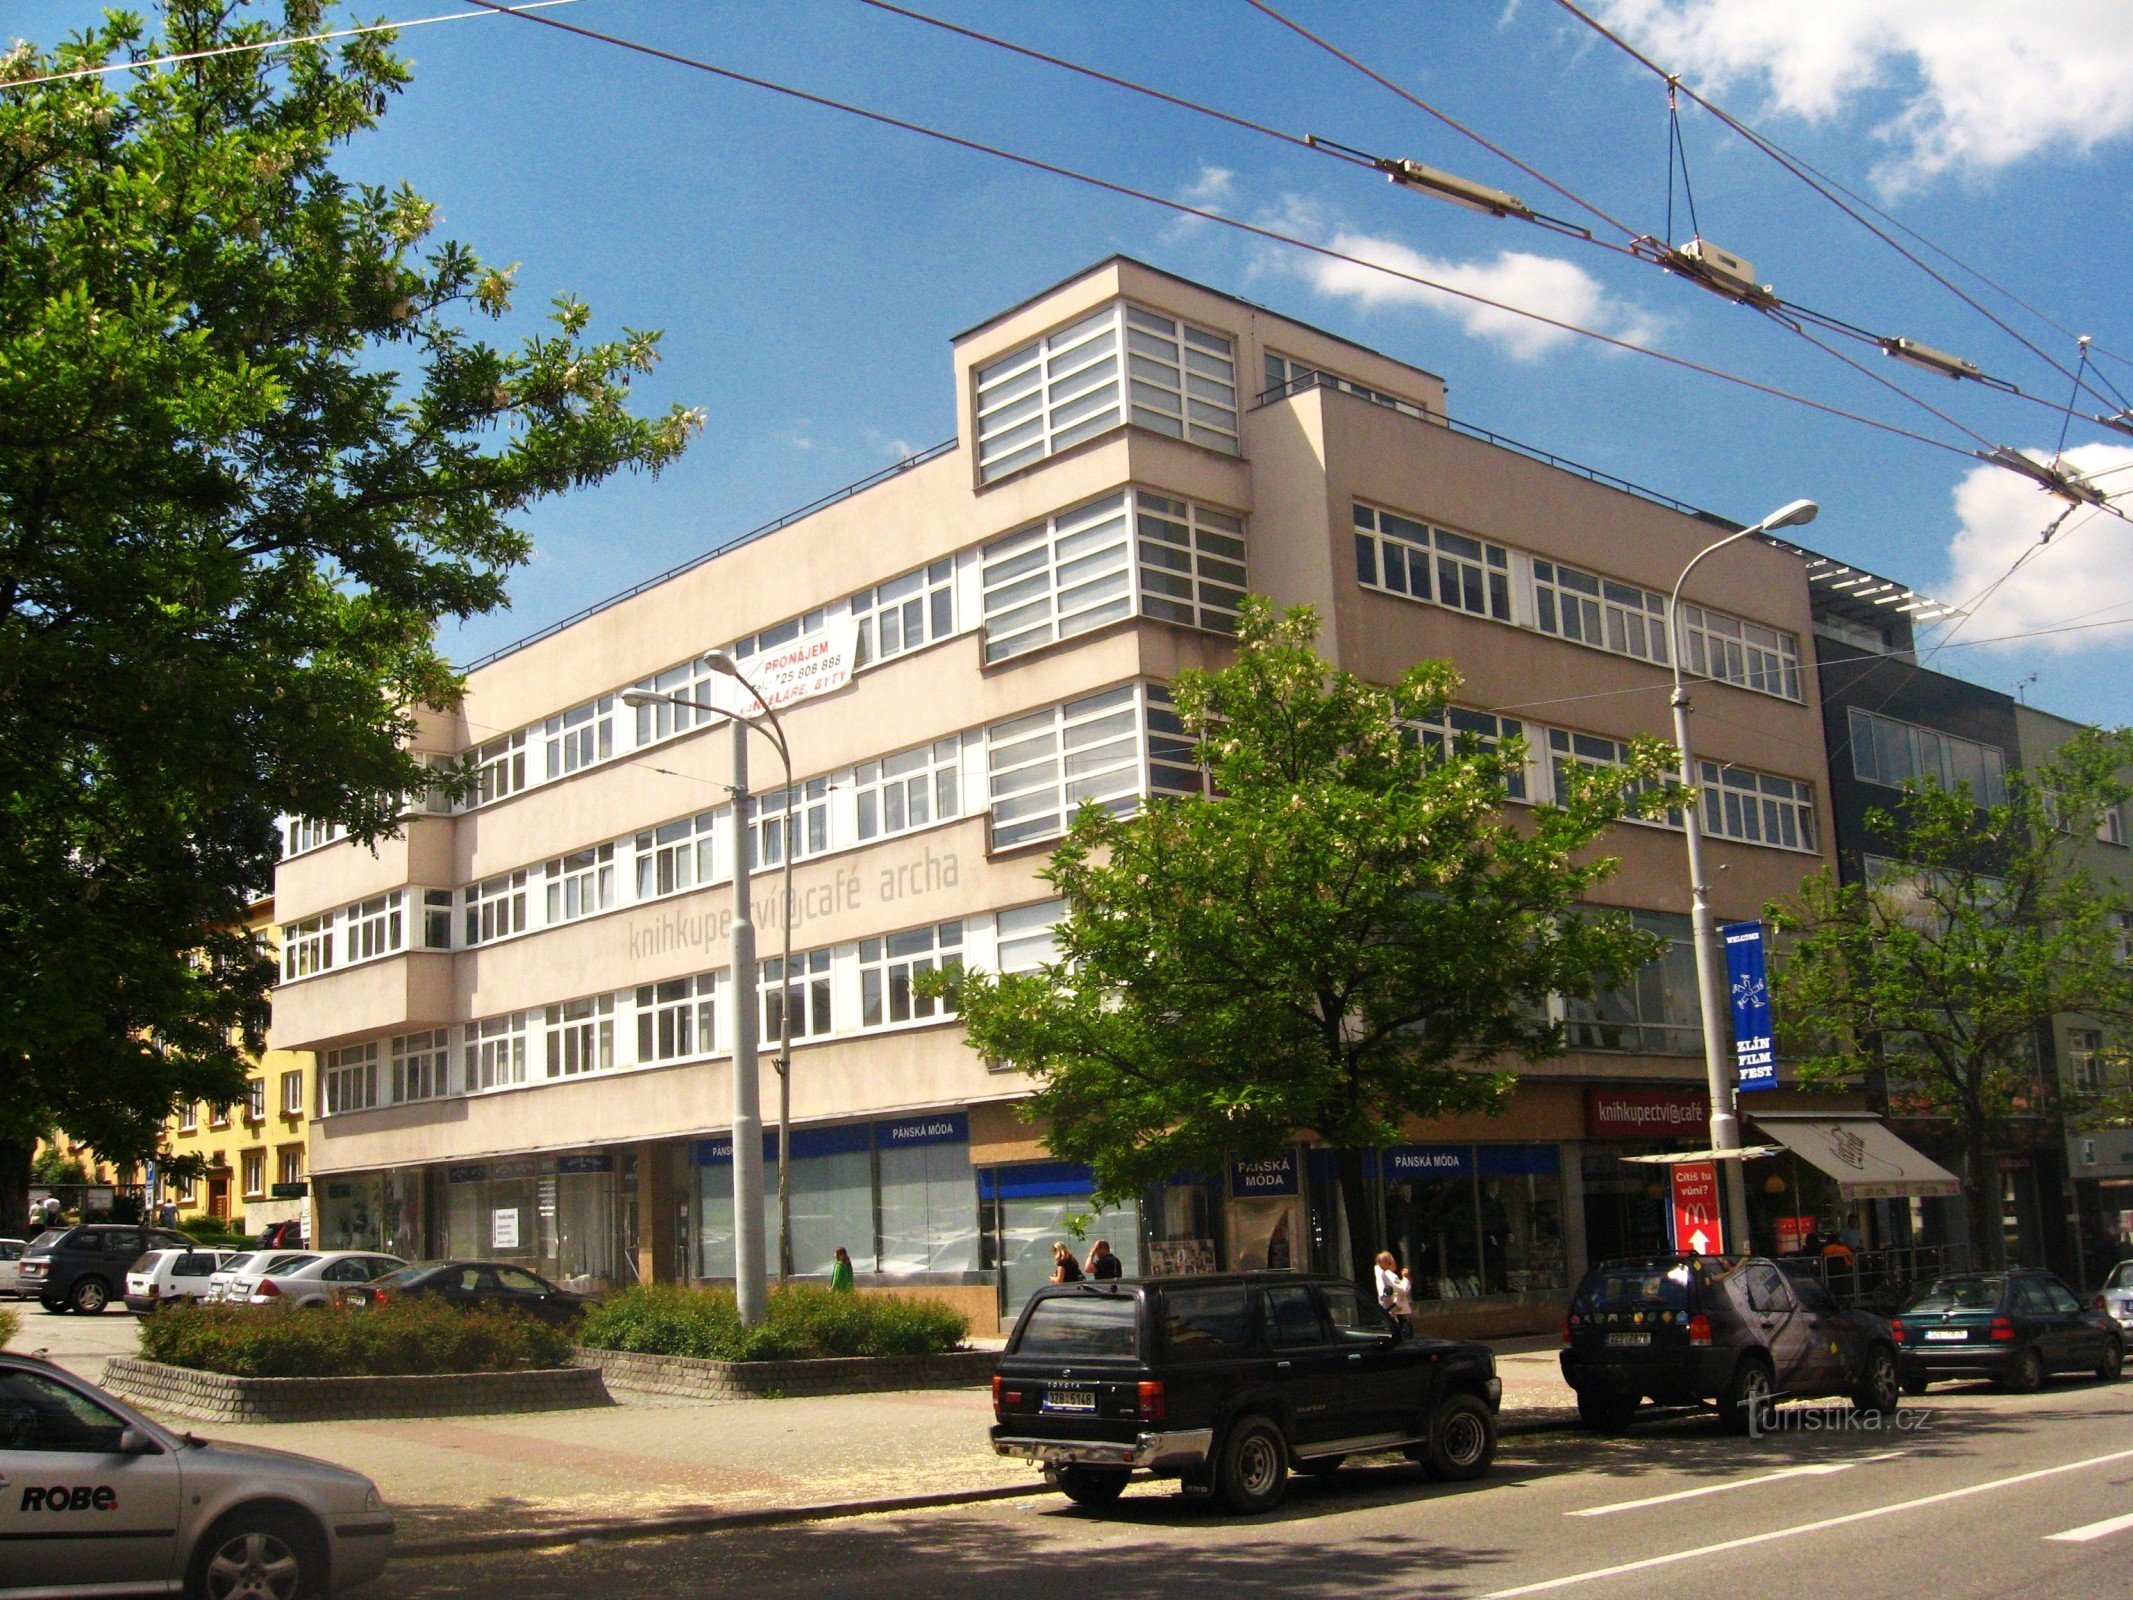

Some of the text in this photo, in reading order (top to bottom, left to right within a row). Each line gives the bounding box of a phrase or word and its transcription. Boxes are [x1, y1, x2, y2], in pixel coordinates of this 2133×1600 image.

[797, 663, 818, 680] 808
[821, 654, 841, 671] 888
[628, 846, 959, 961] knihkupeví@café archa
[1726, 932, 1760, 944] WELCOME
[1737, 1036, 1770, 1053] ZLÍN
[1738, 1052, 1772, 1067] FILM
[1740, 1066, 1773, 1080] FEST
[892, 1122, 954, 1139] PÁNSKÁ MÓDA
[712, 1145, 733, 1157] PÁNS
[1395, 1153, 1460, 1167] PÁNSKÁ MÓDA
[1246, 1173, 1284, 1187] MÓDA
